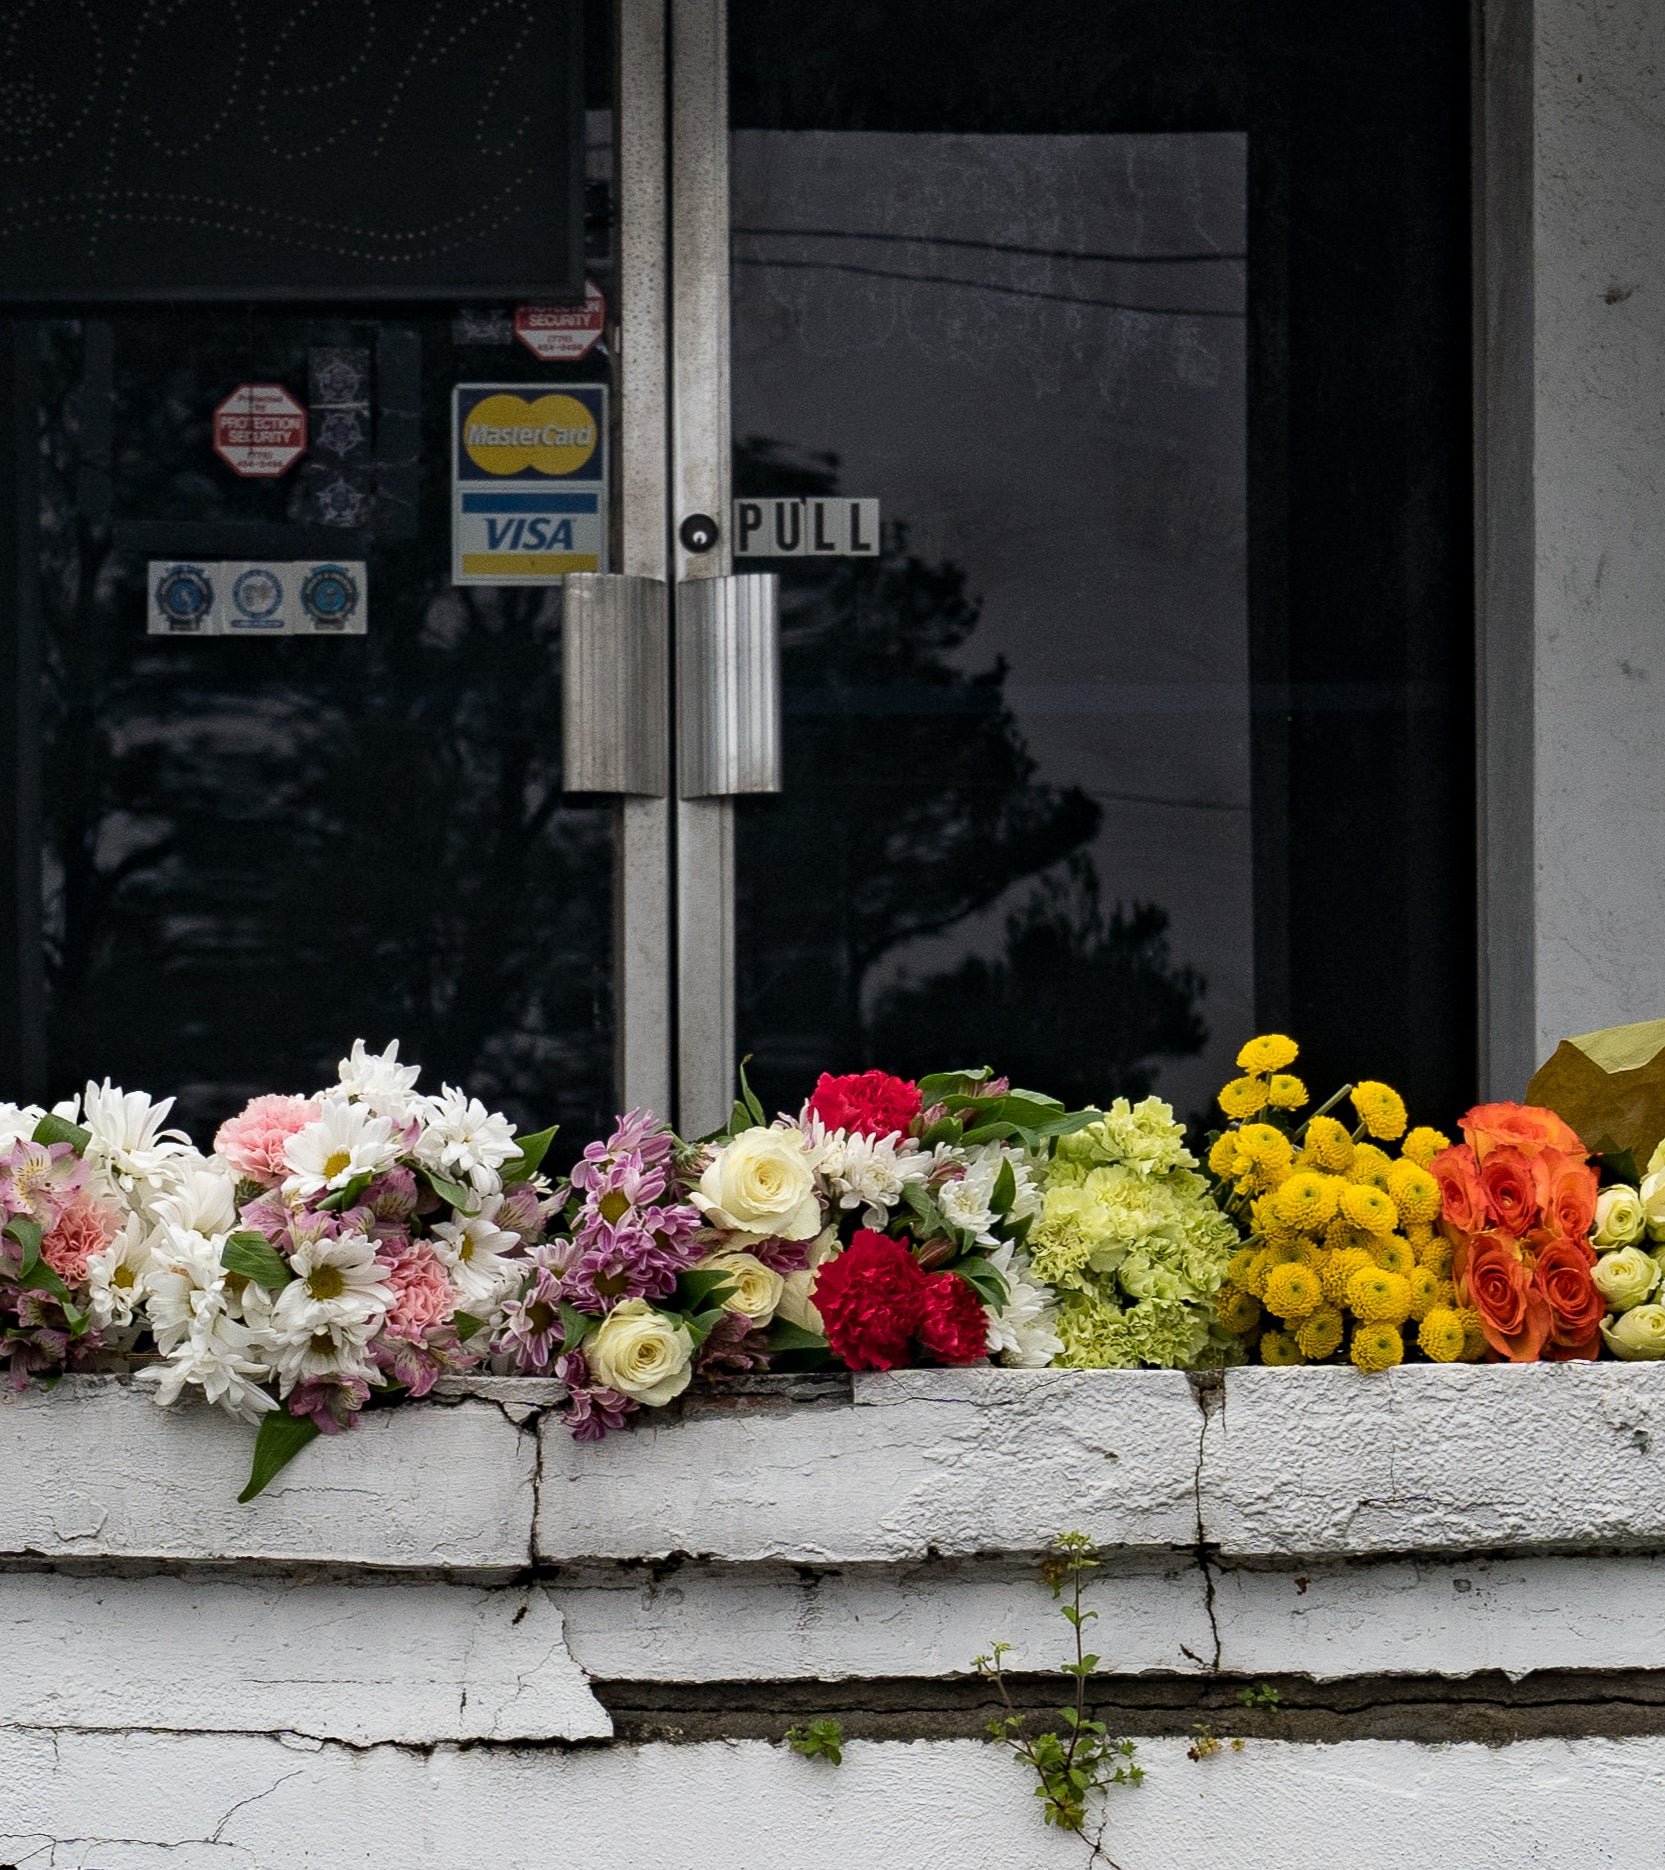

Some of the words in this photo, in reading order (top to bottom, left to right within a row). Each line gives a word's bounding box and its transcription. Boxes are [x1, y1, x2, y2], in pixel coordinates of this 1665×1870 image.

[528, 313, 592, 327] SECURITY
[228, 430, 292, 444] SECURITY
[466, 422, 593, 446] MasterCard
[484, 517, 576, 551] VISA
[738, 502, 871, 552] PULL
